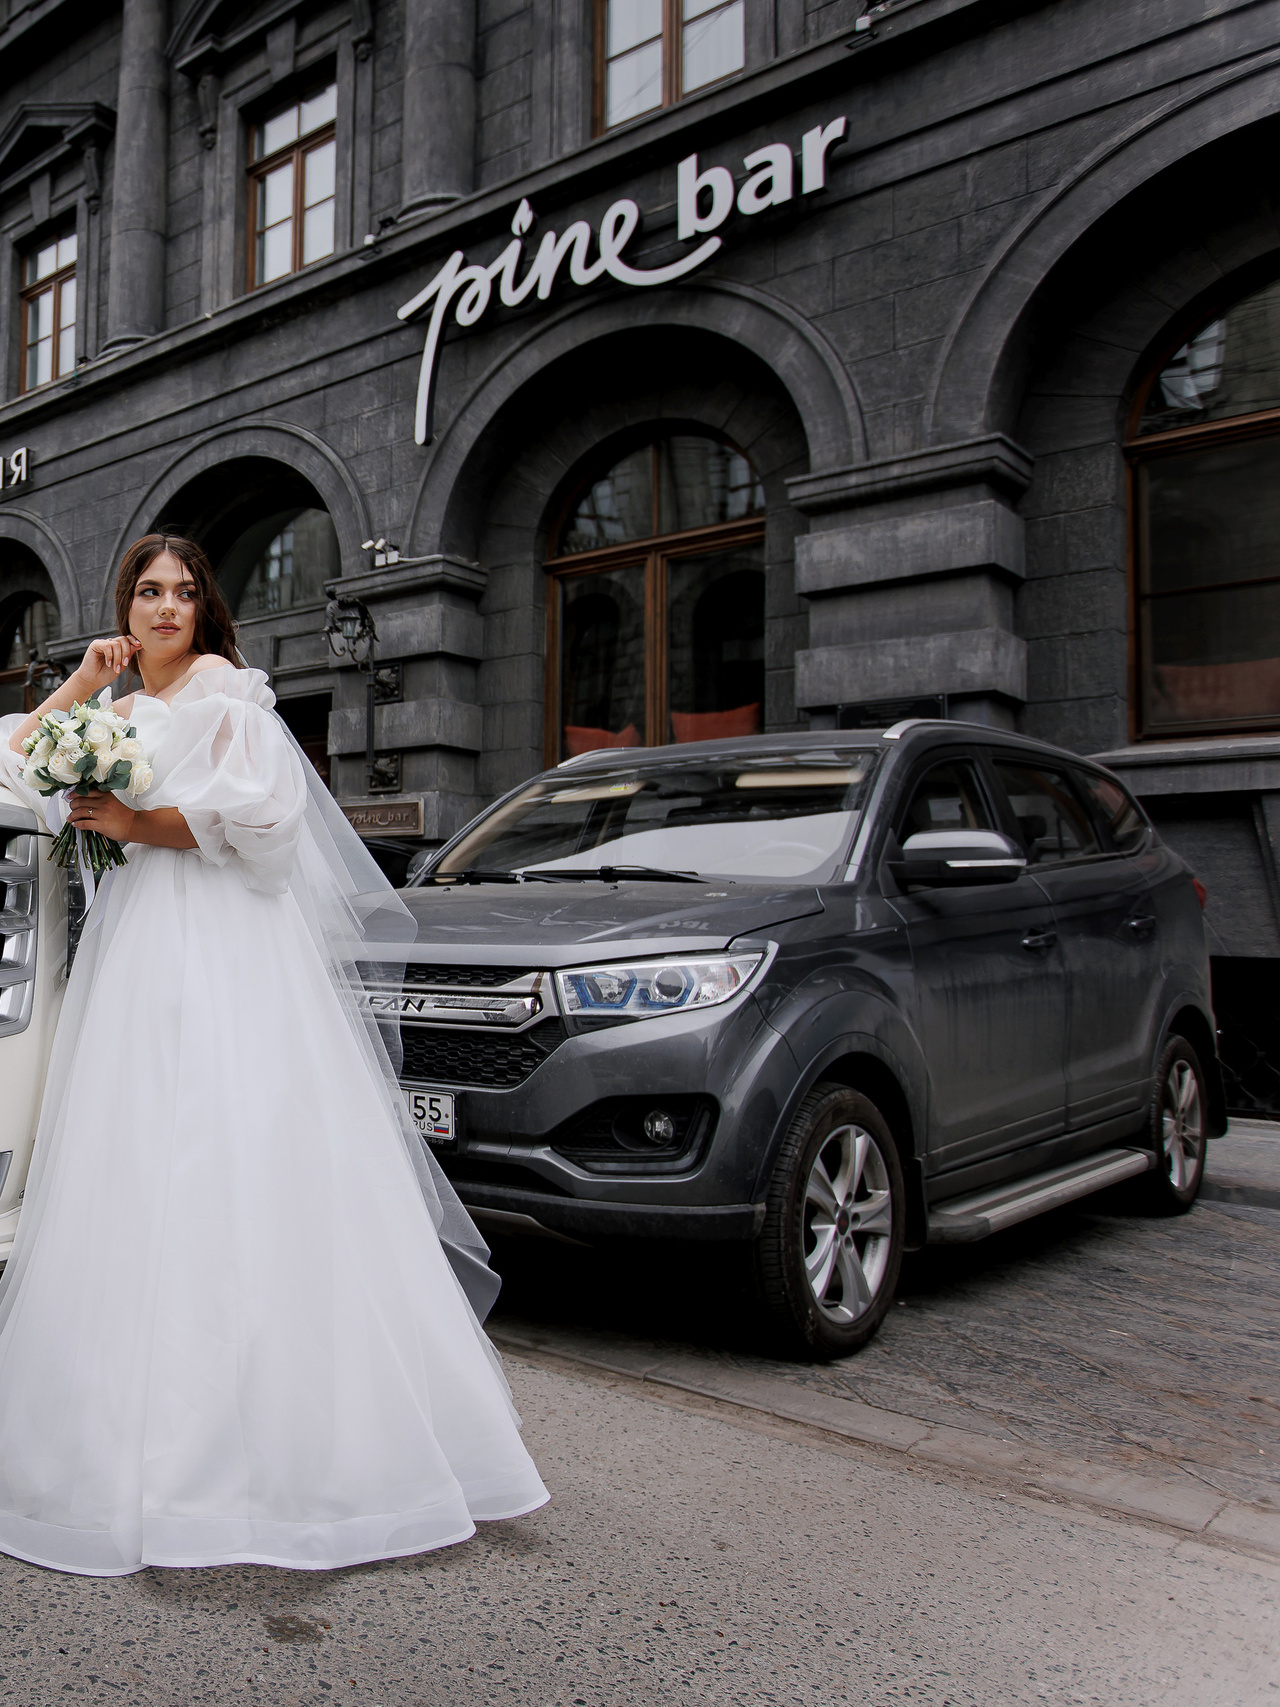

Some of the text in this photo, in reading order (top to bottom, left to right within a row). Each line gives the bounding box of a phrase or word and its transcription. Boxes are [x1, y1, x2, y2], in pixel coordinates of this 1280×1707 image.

[397, 116, 847, 445] pine bar
[349, 811, 409, 827] pine bar
